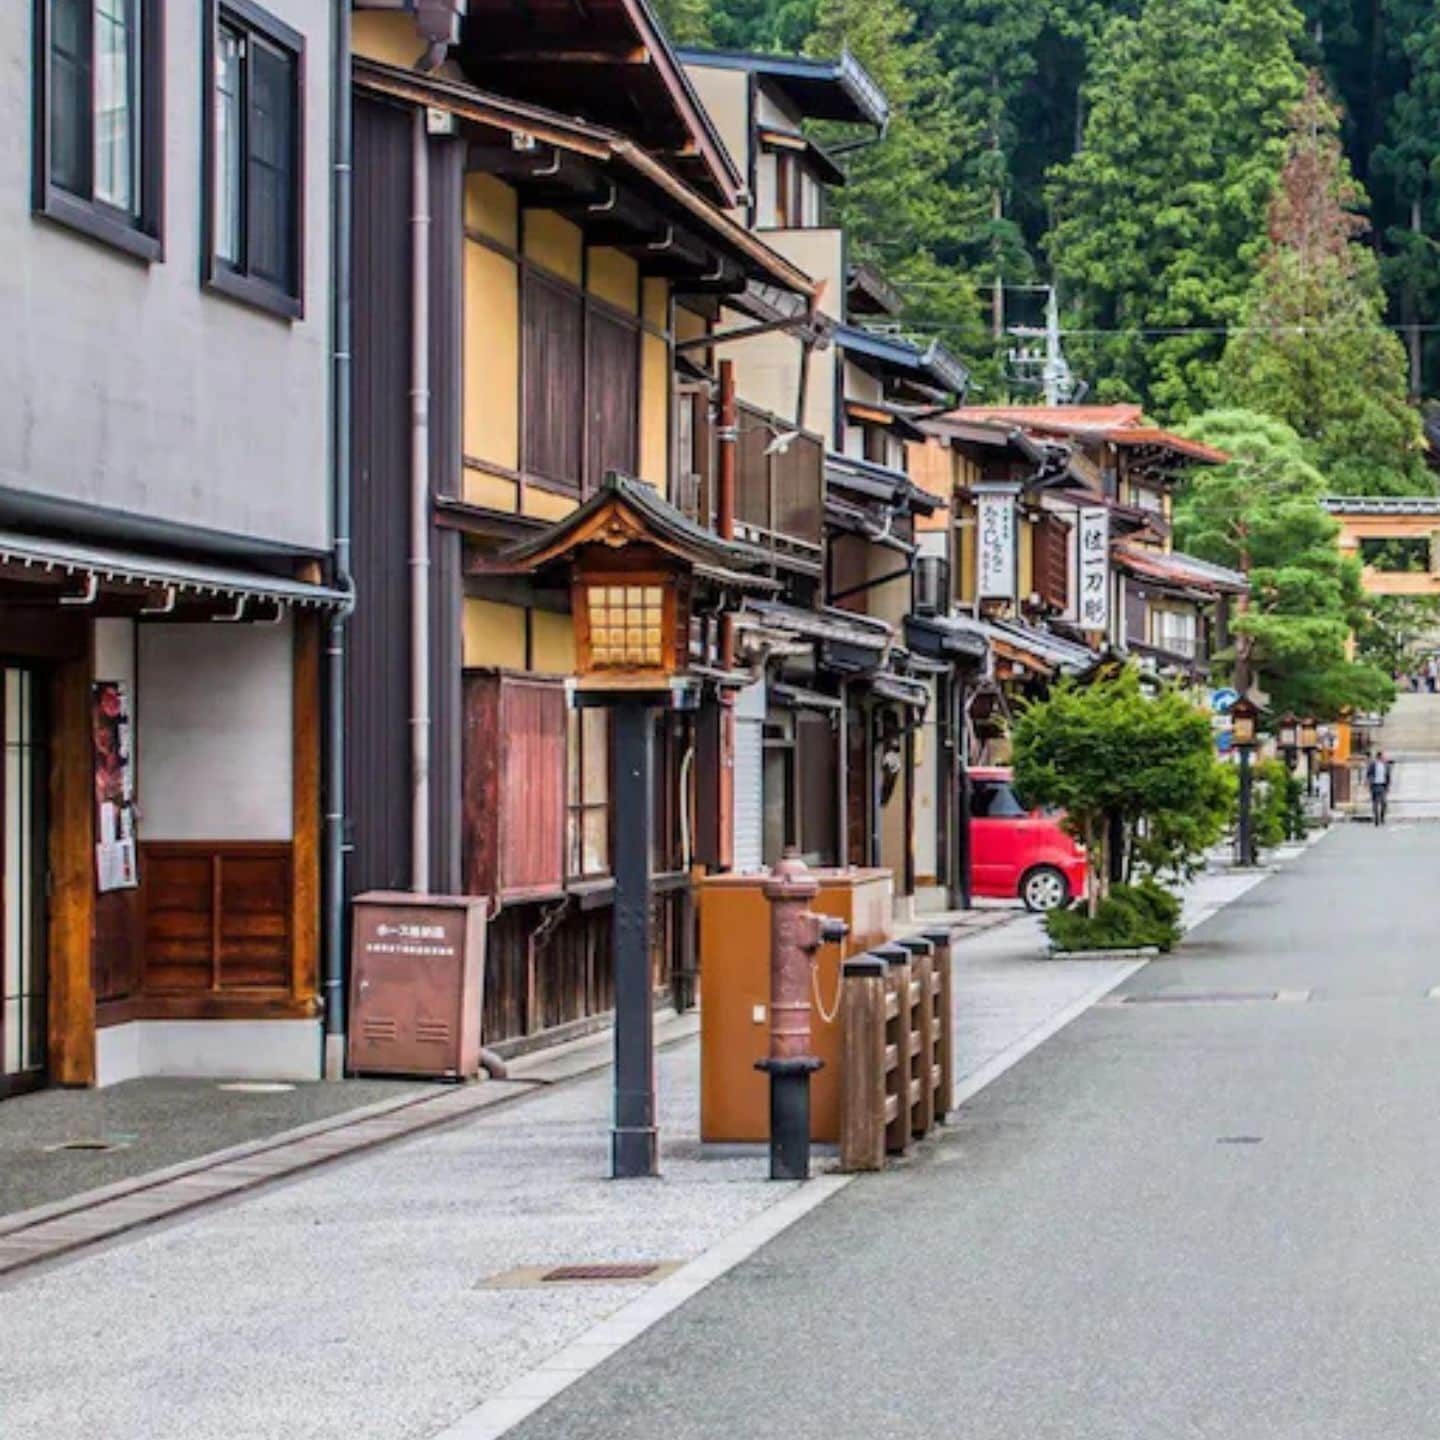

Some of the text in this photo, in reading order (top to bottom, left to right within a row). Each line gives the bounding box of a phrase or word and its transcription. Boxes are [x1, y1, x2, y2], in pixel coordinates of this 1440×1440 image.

[1083, 512, 1106, 623] 一位一刀彫
